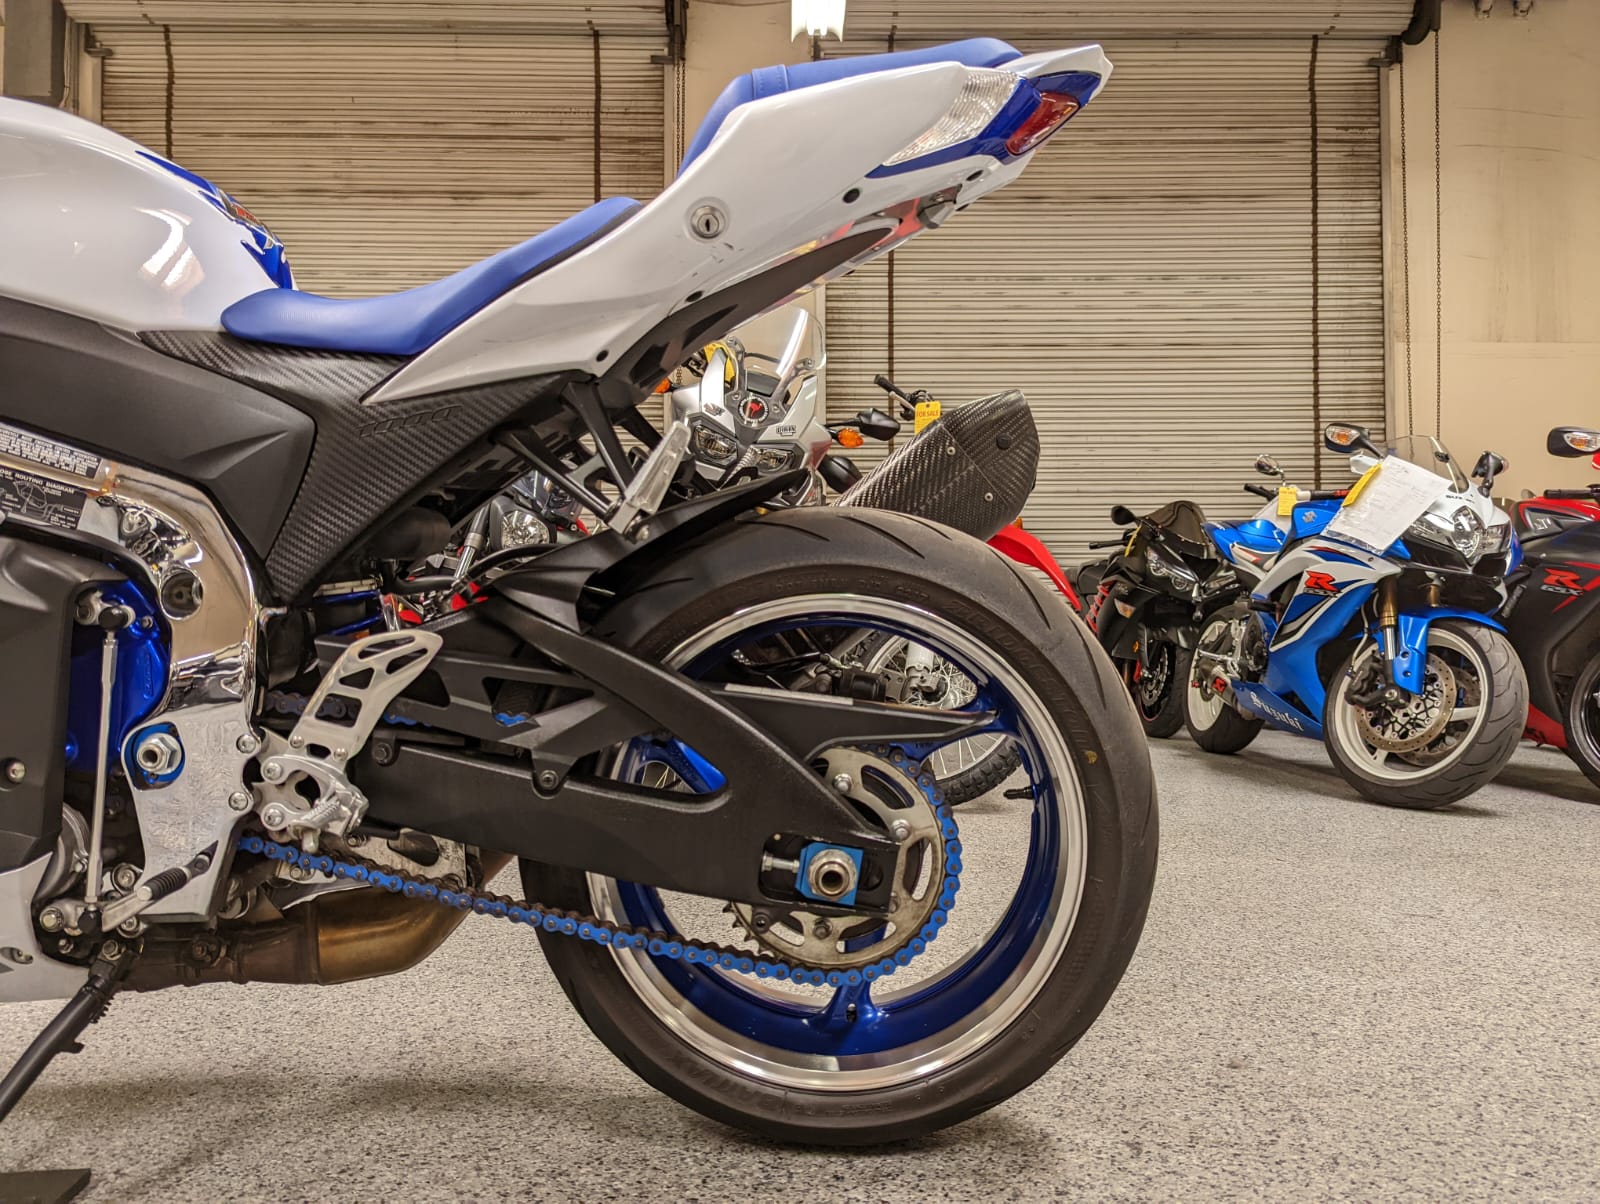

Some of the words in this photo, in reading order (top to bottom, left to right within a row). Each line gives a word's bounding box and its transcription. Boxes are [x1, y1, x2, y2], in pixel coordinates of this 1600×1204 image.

[15, 473, 44, 485] ROUTING
[46, 481, 75, 494] DIAGRAM
[1304, 571, 1341, 592] R
[1543, 568, 1584, 590] R
[1250, 691, 1304, 732] Suzuki
